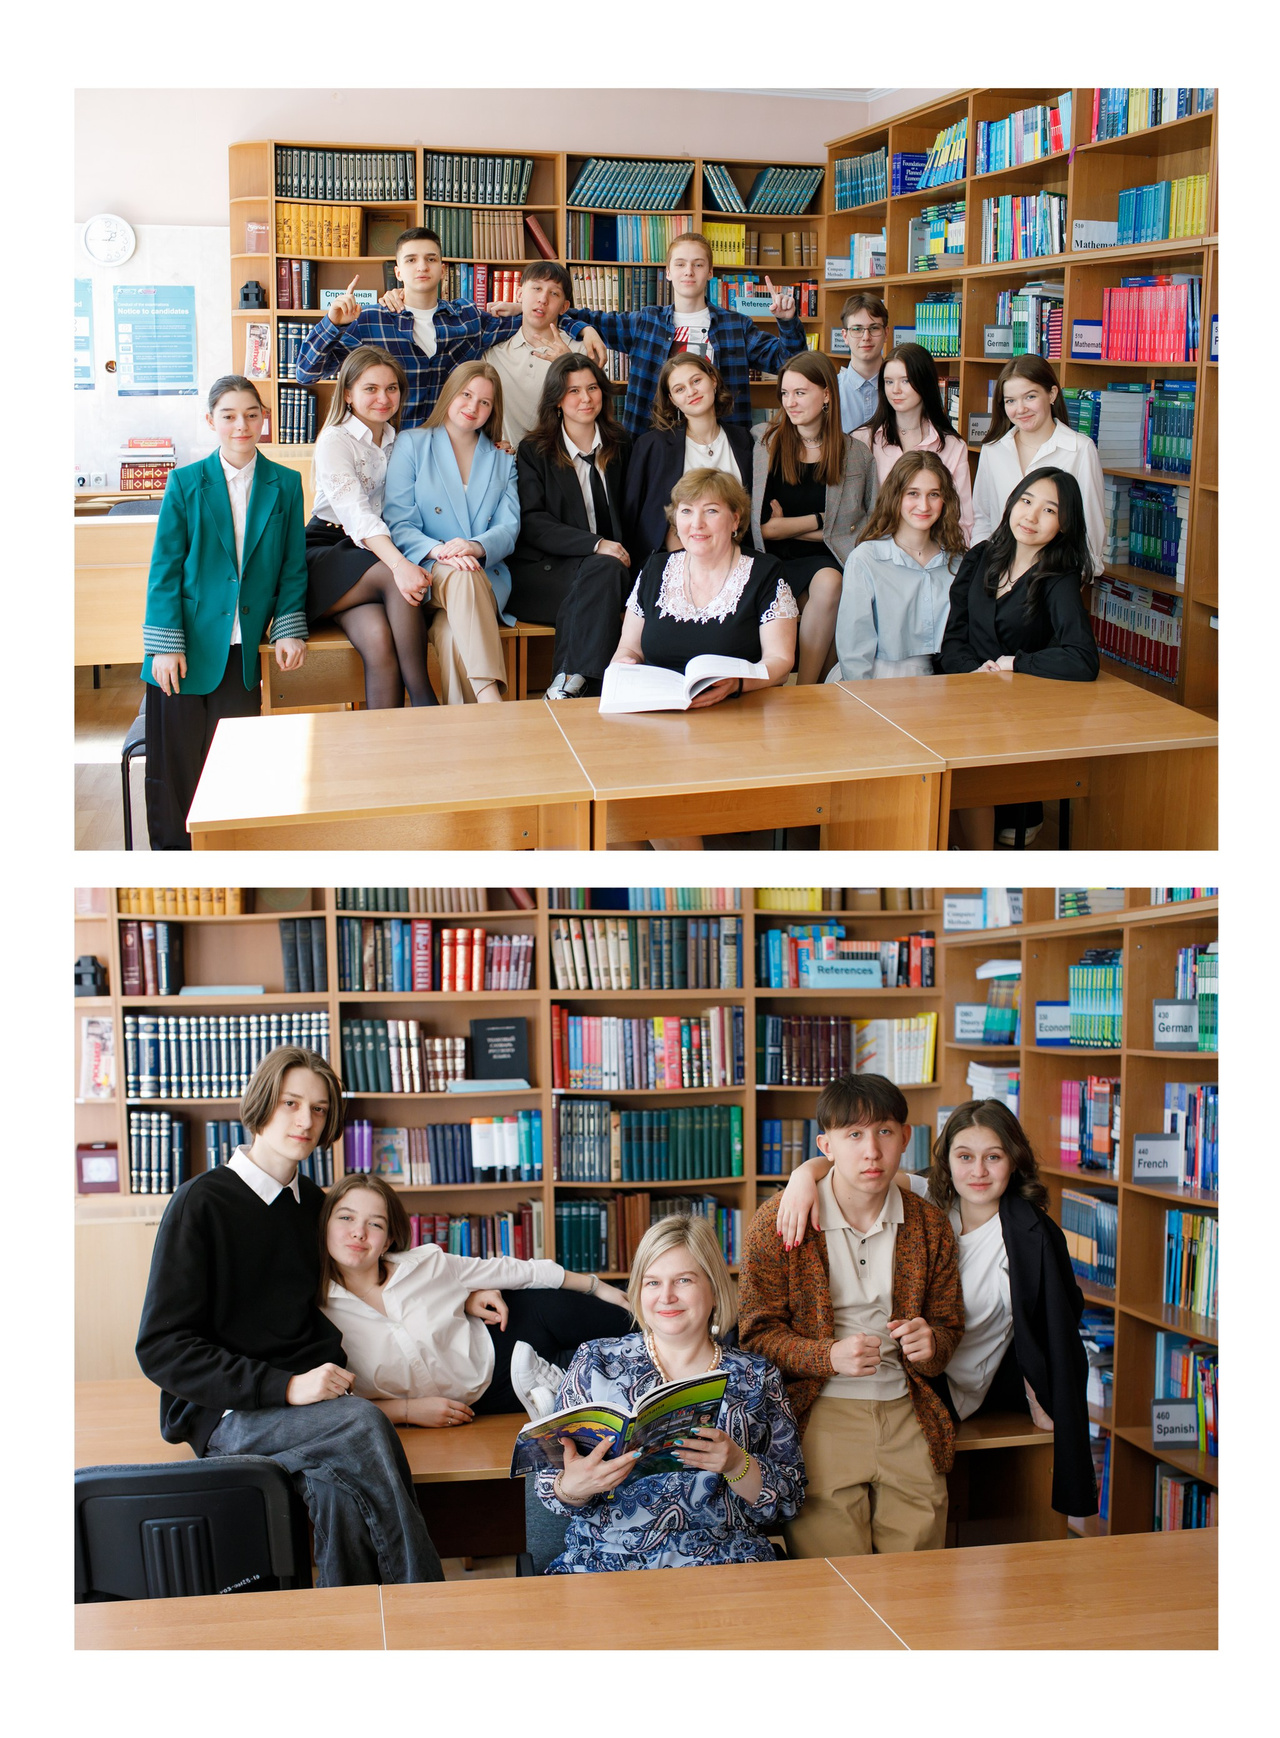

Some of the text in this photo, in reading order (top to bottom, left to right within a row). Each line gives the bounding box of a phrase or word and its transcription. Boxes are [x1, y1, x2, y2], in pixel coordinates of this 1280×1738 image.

[1074, 240, 1119, 249] Mathemat
[987, 339, 1010, 347] German
[817, 965, 874, 975] References
[1158, 1011, 1169, 1019] 430
[1039, 1023, 1070, 1032] Econom
[1158, 1022, 1194, 1033] German
[1138, 1159, 1168, 1169] French
[1156, 1411, 1170, 1420] 460
[1156, 1423, 1195, 1437] Spanish
